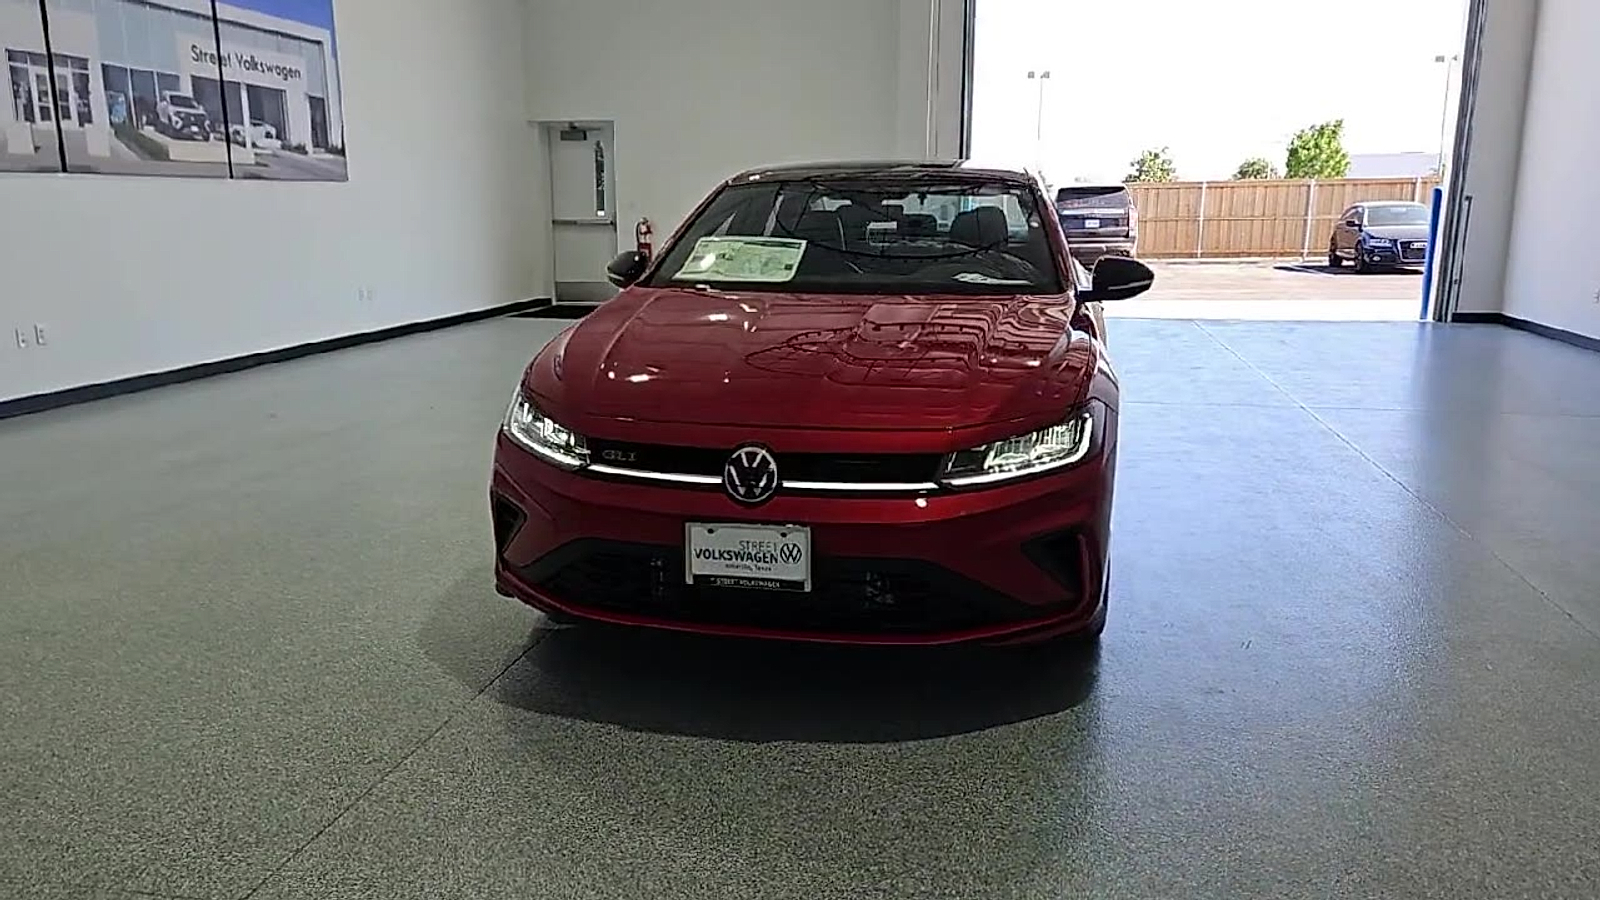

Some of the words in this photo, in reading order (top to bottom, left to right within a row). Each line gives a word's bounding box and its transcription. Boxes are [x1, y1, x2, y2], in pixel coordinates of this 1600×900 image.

[191, 44, 232, 68] Street
[234, 51, 302, 81] Volkswagen
[602, 450, 638, 461] GLI
[739, 541, 777, 552] STREET
[694, 548, 778, 563] VOLKSWAGEN
